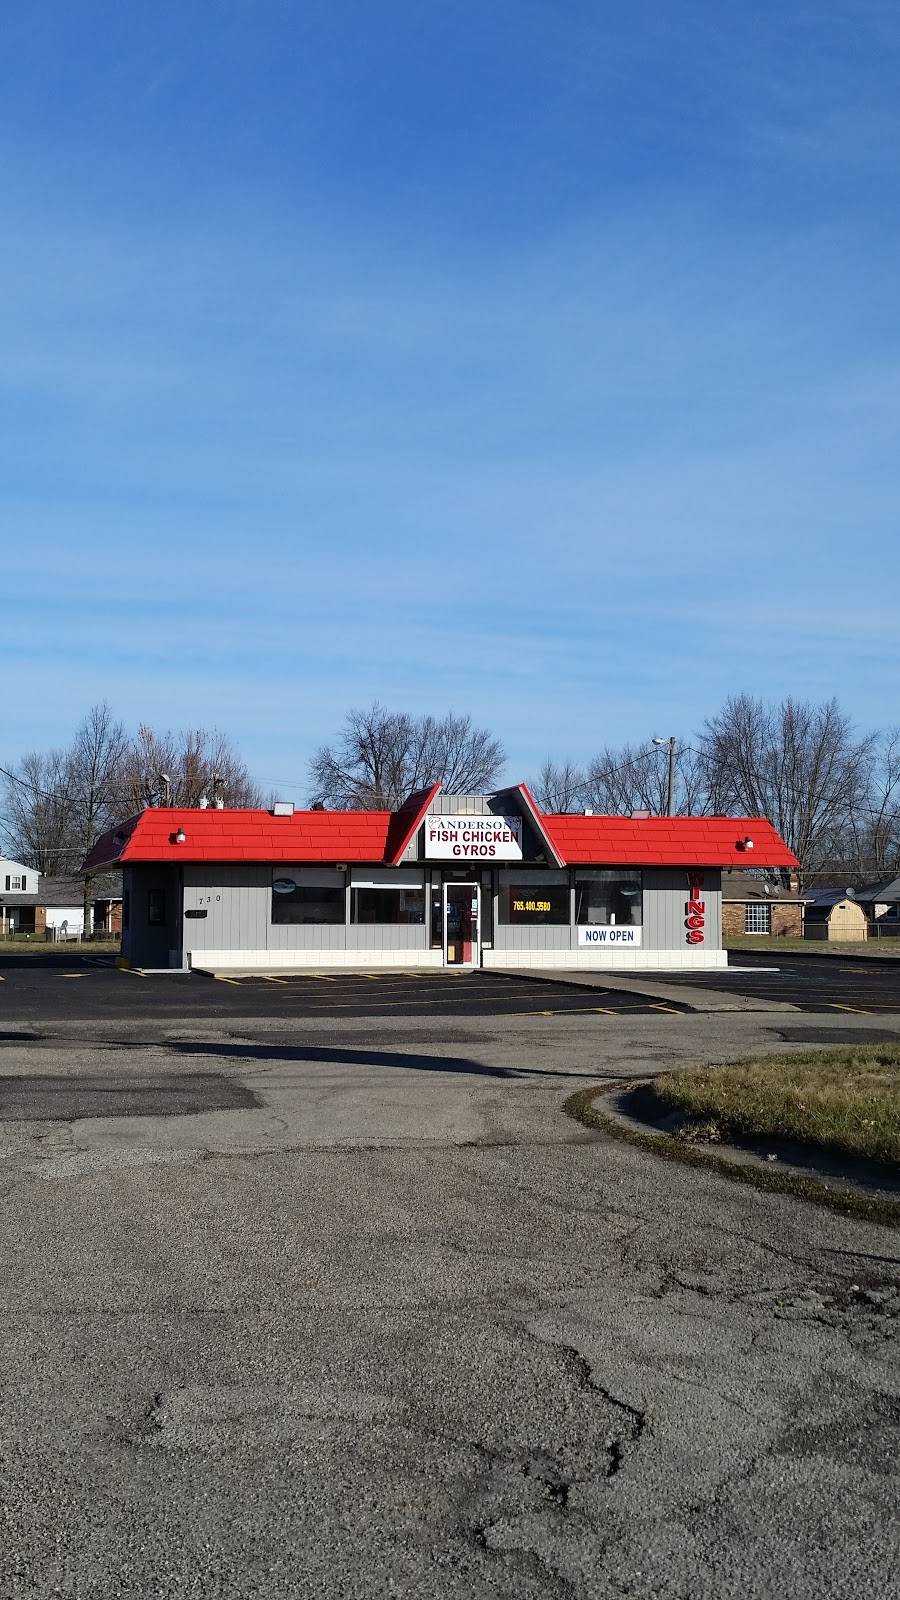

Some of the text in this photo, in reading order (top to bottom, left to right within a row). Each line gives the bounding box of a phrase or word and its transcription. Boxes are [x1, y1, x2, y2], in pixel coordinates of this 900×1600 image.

[429, 830, 519, 843] FISH CHICKEN
[452, 844, 496, 856] GYROS
[585, 930, 634, 942] NOW OPEN
